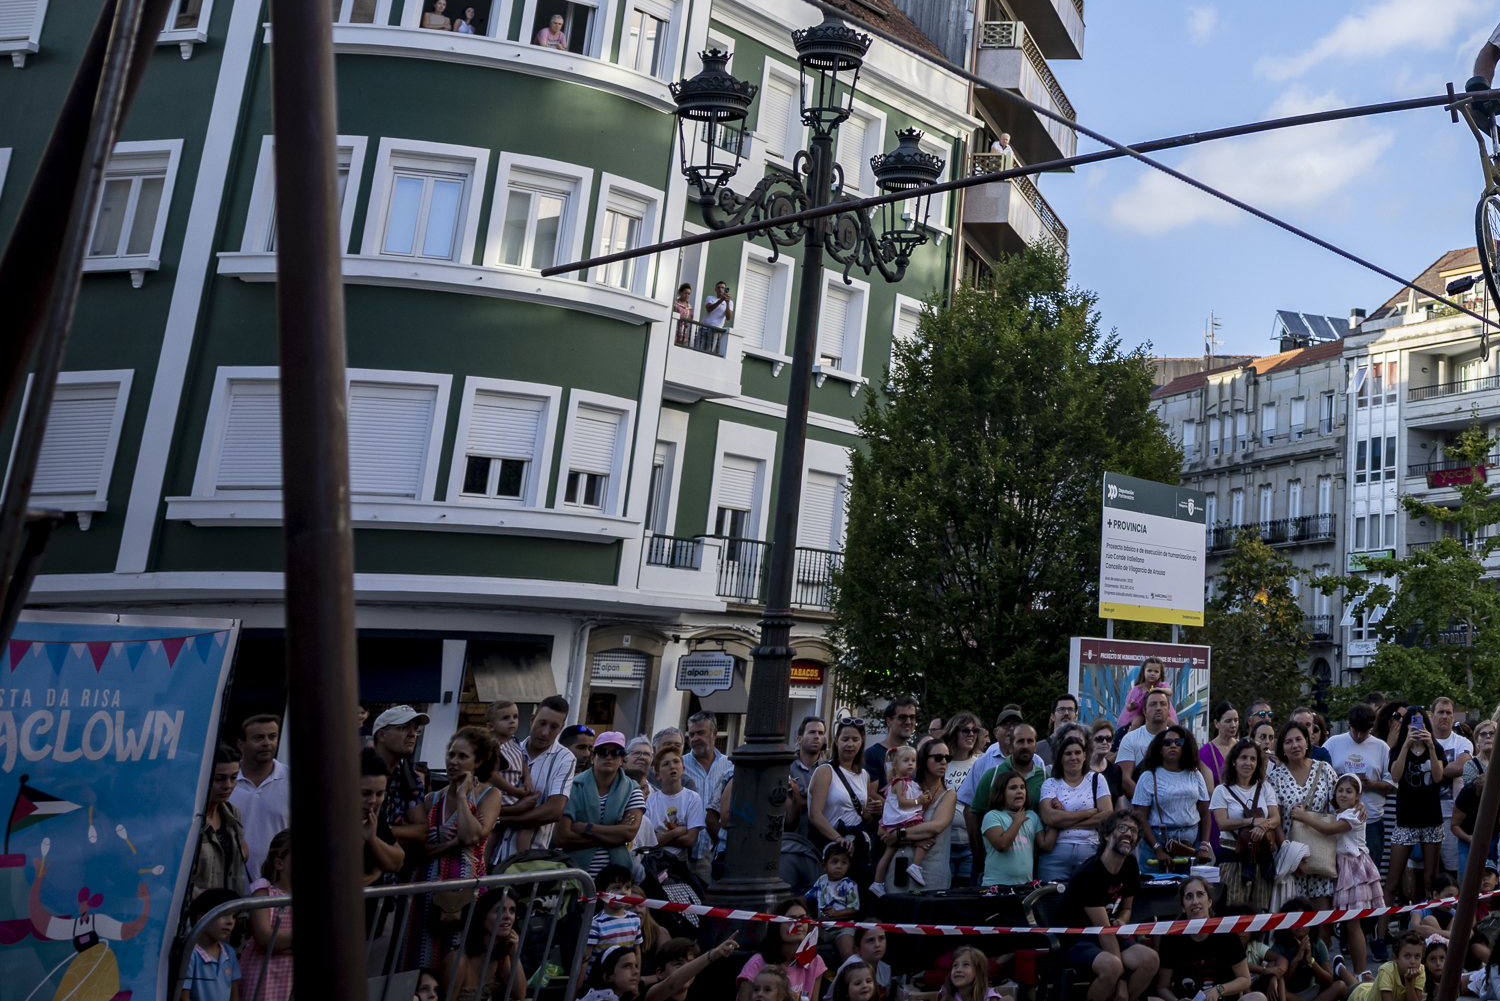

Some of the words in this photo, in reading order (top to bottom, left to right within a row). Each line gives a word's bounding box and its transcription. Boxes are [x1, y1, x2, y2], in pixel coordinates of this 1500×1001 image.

[1438, 470, 1472, 484] YOGA
[1113, 519, 1147, 534] PROVINCIA
[1114, 553, 1126, 561] Conde
[790, 668, 819, 677] TABACOS
[46, 689, 69, 708] DA
[81, 690, 121, 708] RISA
